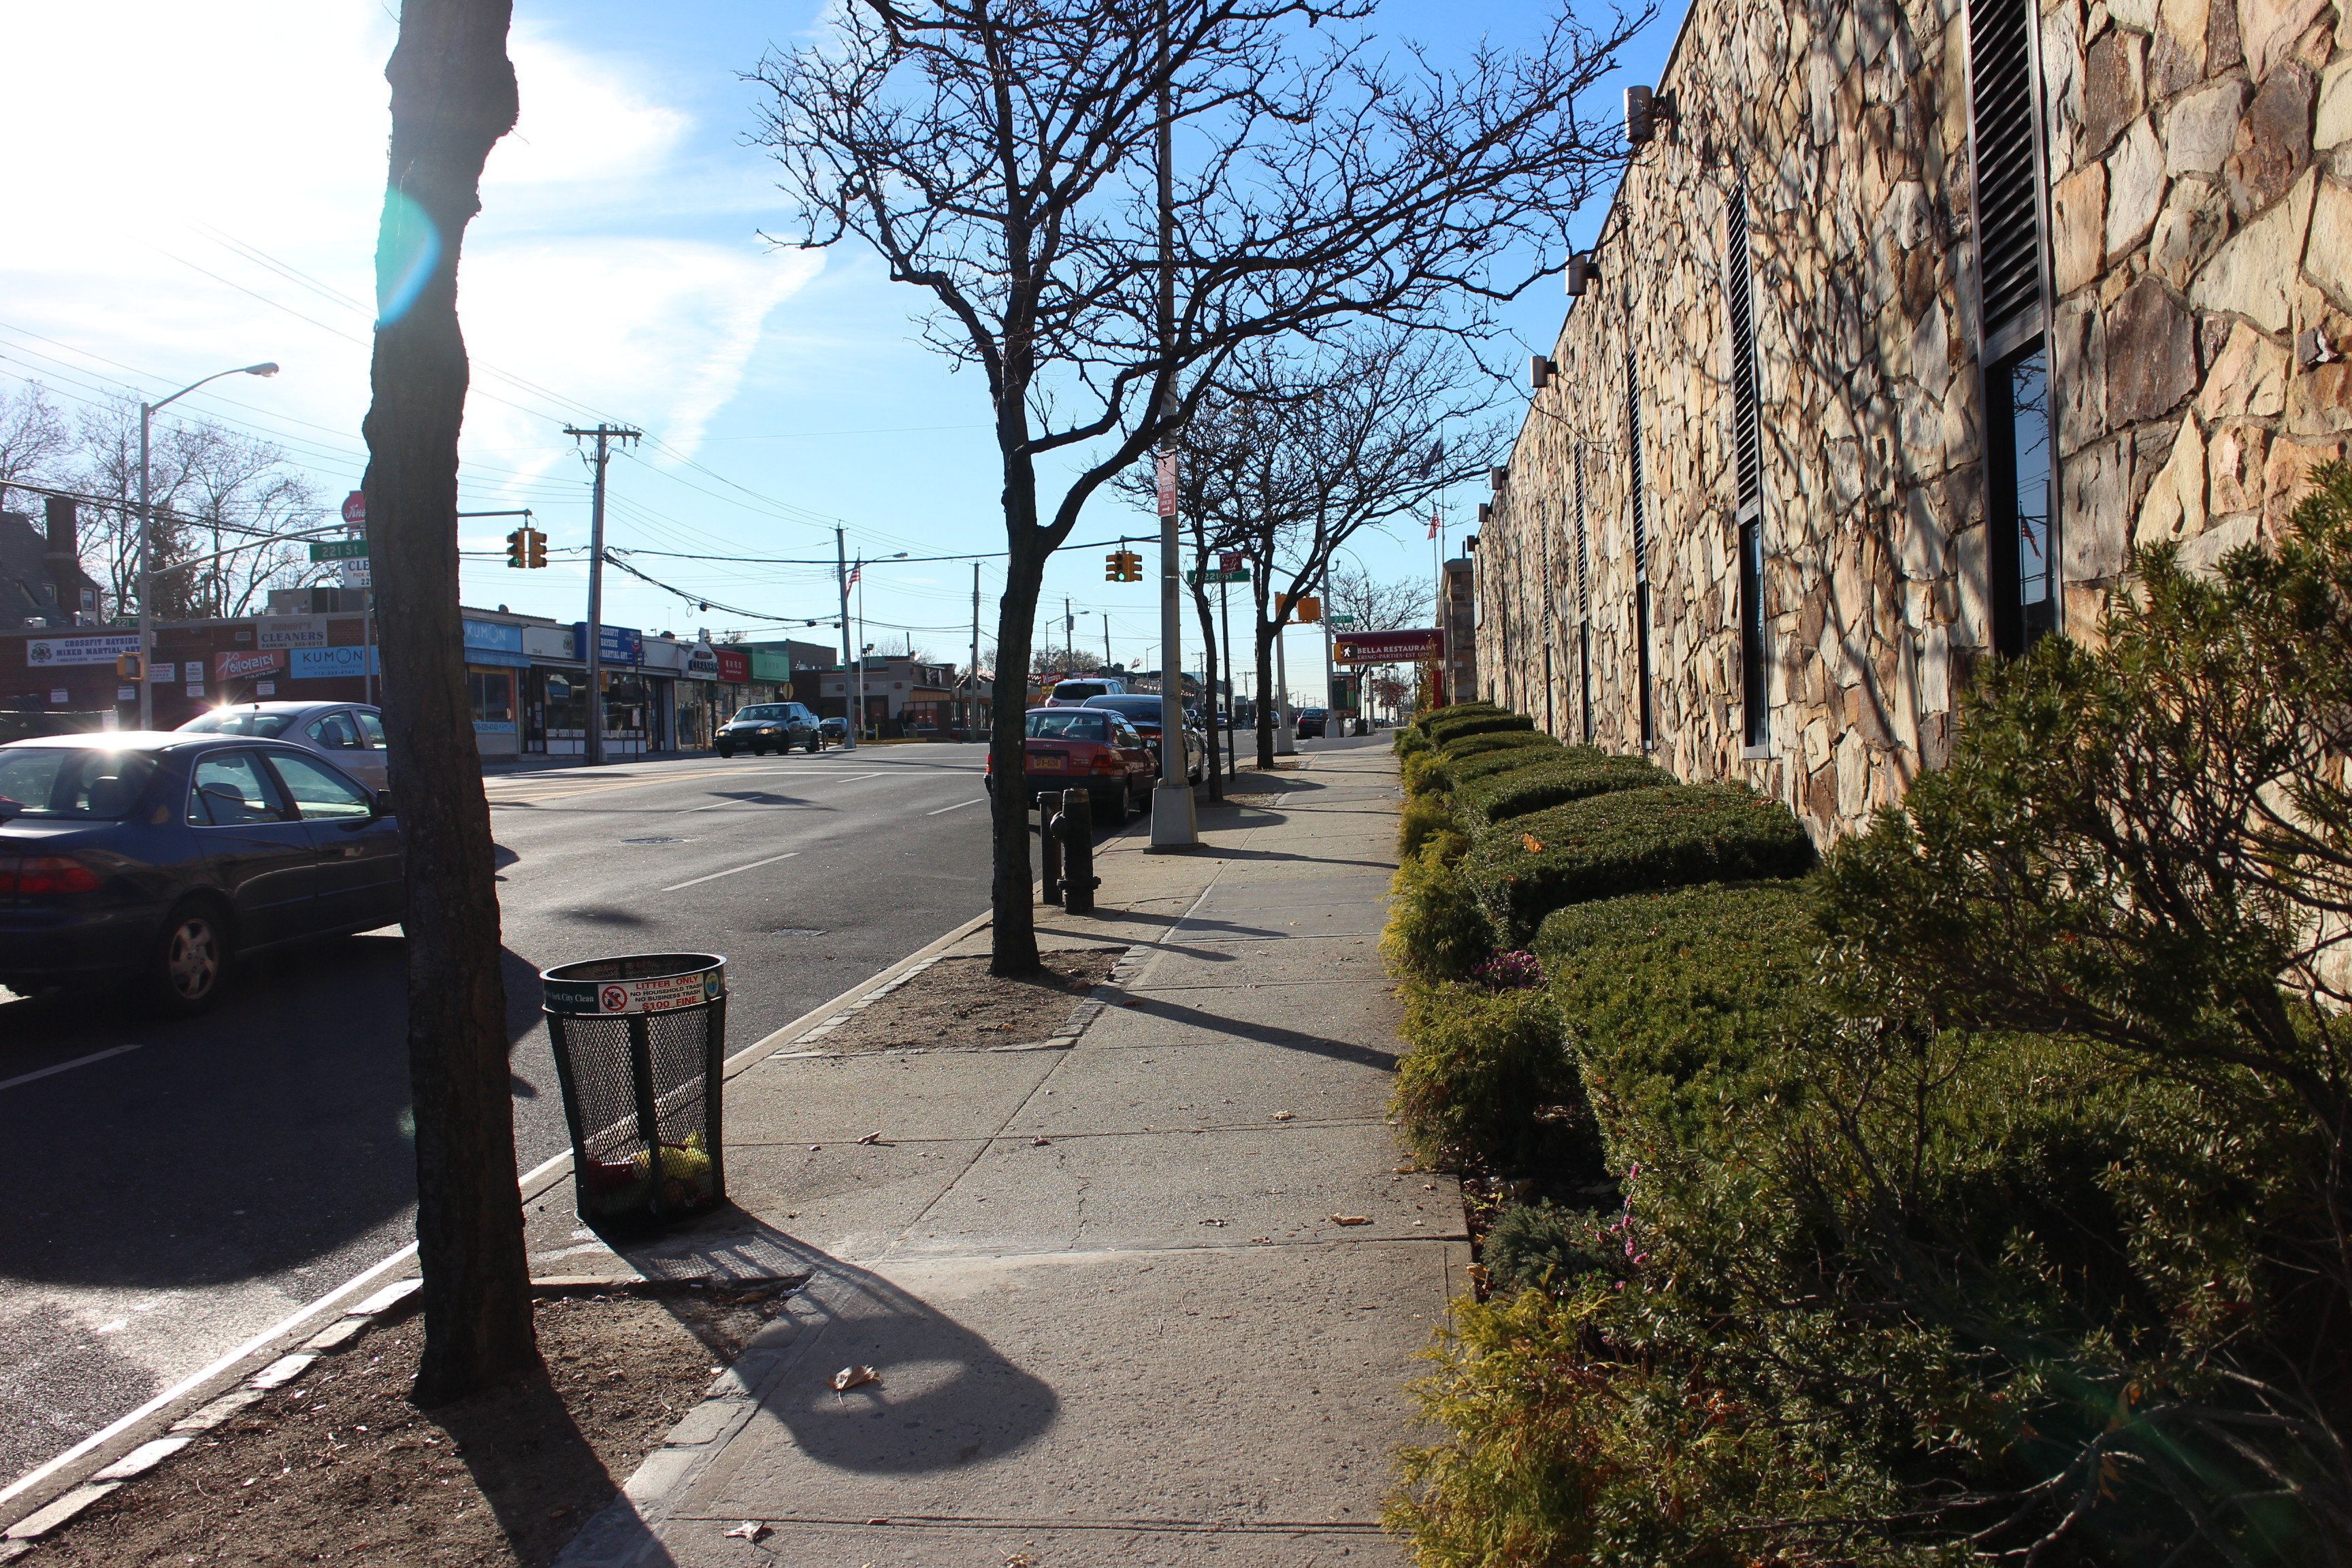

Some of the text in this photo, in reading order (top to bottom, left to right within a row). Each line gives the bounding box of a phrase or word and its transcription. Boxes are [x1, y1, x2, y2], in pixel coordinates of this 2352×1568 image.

[321, 544, 359, 557] 221 St
[116, 619, 129, 627] 221
[261, 632, 324, 642] CLEANERS
[467, 623, 506, 643] KUMON
[65, 637, 138, 647] CROSSFIT BAYSIDE
[56, 648, 82, 656] MIXED
[86, 647, 121, 655] MARTIAL
[303, 648, 363, 664] KUMON
[229, 653, 274, 673] 헤어리더
[636, 975, 699, 990] LITTER ONLY
[643, 987, 685, 996] HOUSEHOLD
[561, 994, 573, 1002] City
[575, 994, 594, 1002] Clean
[648, 993, 681, 1001] BUSINESS
[642, 996, 698, 1010] $100 FINE
